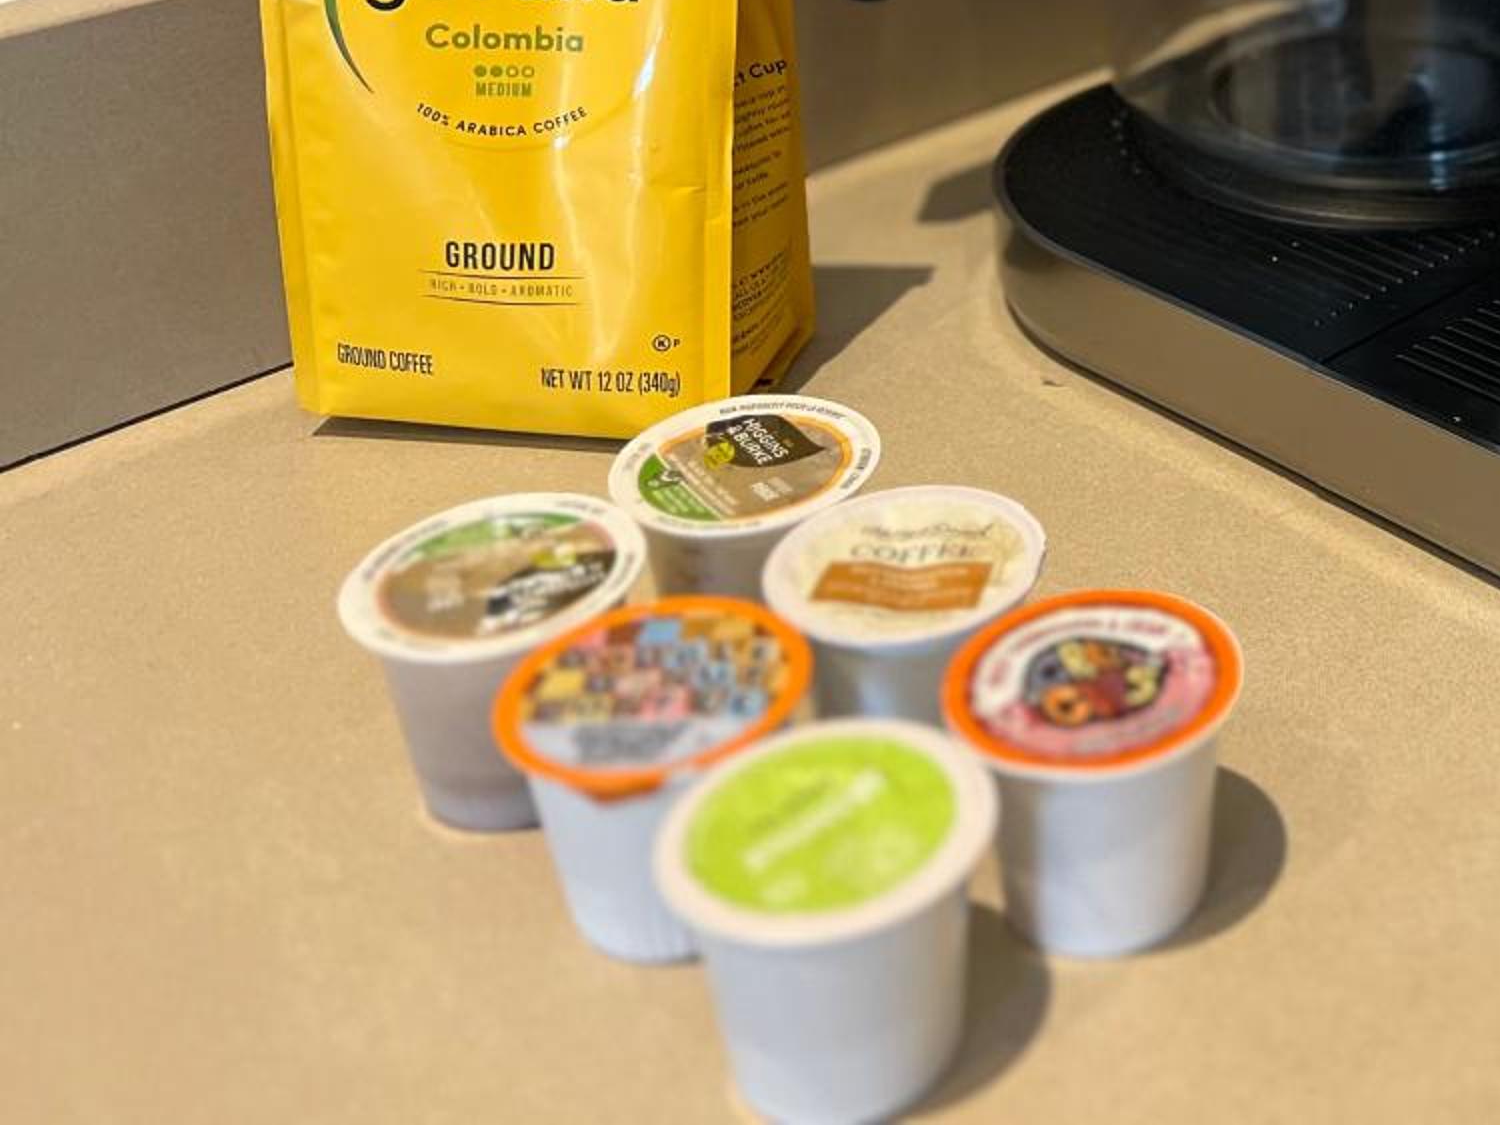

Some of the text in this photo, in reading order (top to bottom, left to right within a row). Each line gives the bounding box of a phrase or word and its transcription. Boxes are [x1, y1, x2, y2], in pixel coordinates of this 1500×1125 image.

[425, 22, 584, 52] Colombia
[749, 59, 788, 79] Cup
[475, 82, 533, 97] MEDIUM
[416, 102, 588, 137] 100% ARABICA COFFEE
[445, 240, 556, 271] GROUND
[430, 278, 574, 298] RICH BOLD AROMATIC
[337, 342, 434, 375] GROUND COFFEE
[541, 367, 681, 397] NET WT 12 OZ (340g)
[733, 432, 773, 466] BURKE
[742, 418, 789, 459] HIGGINS
